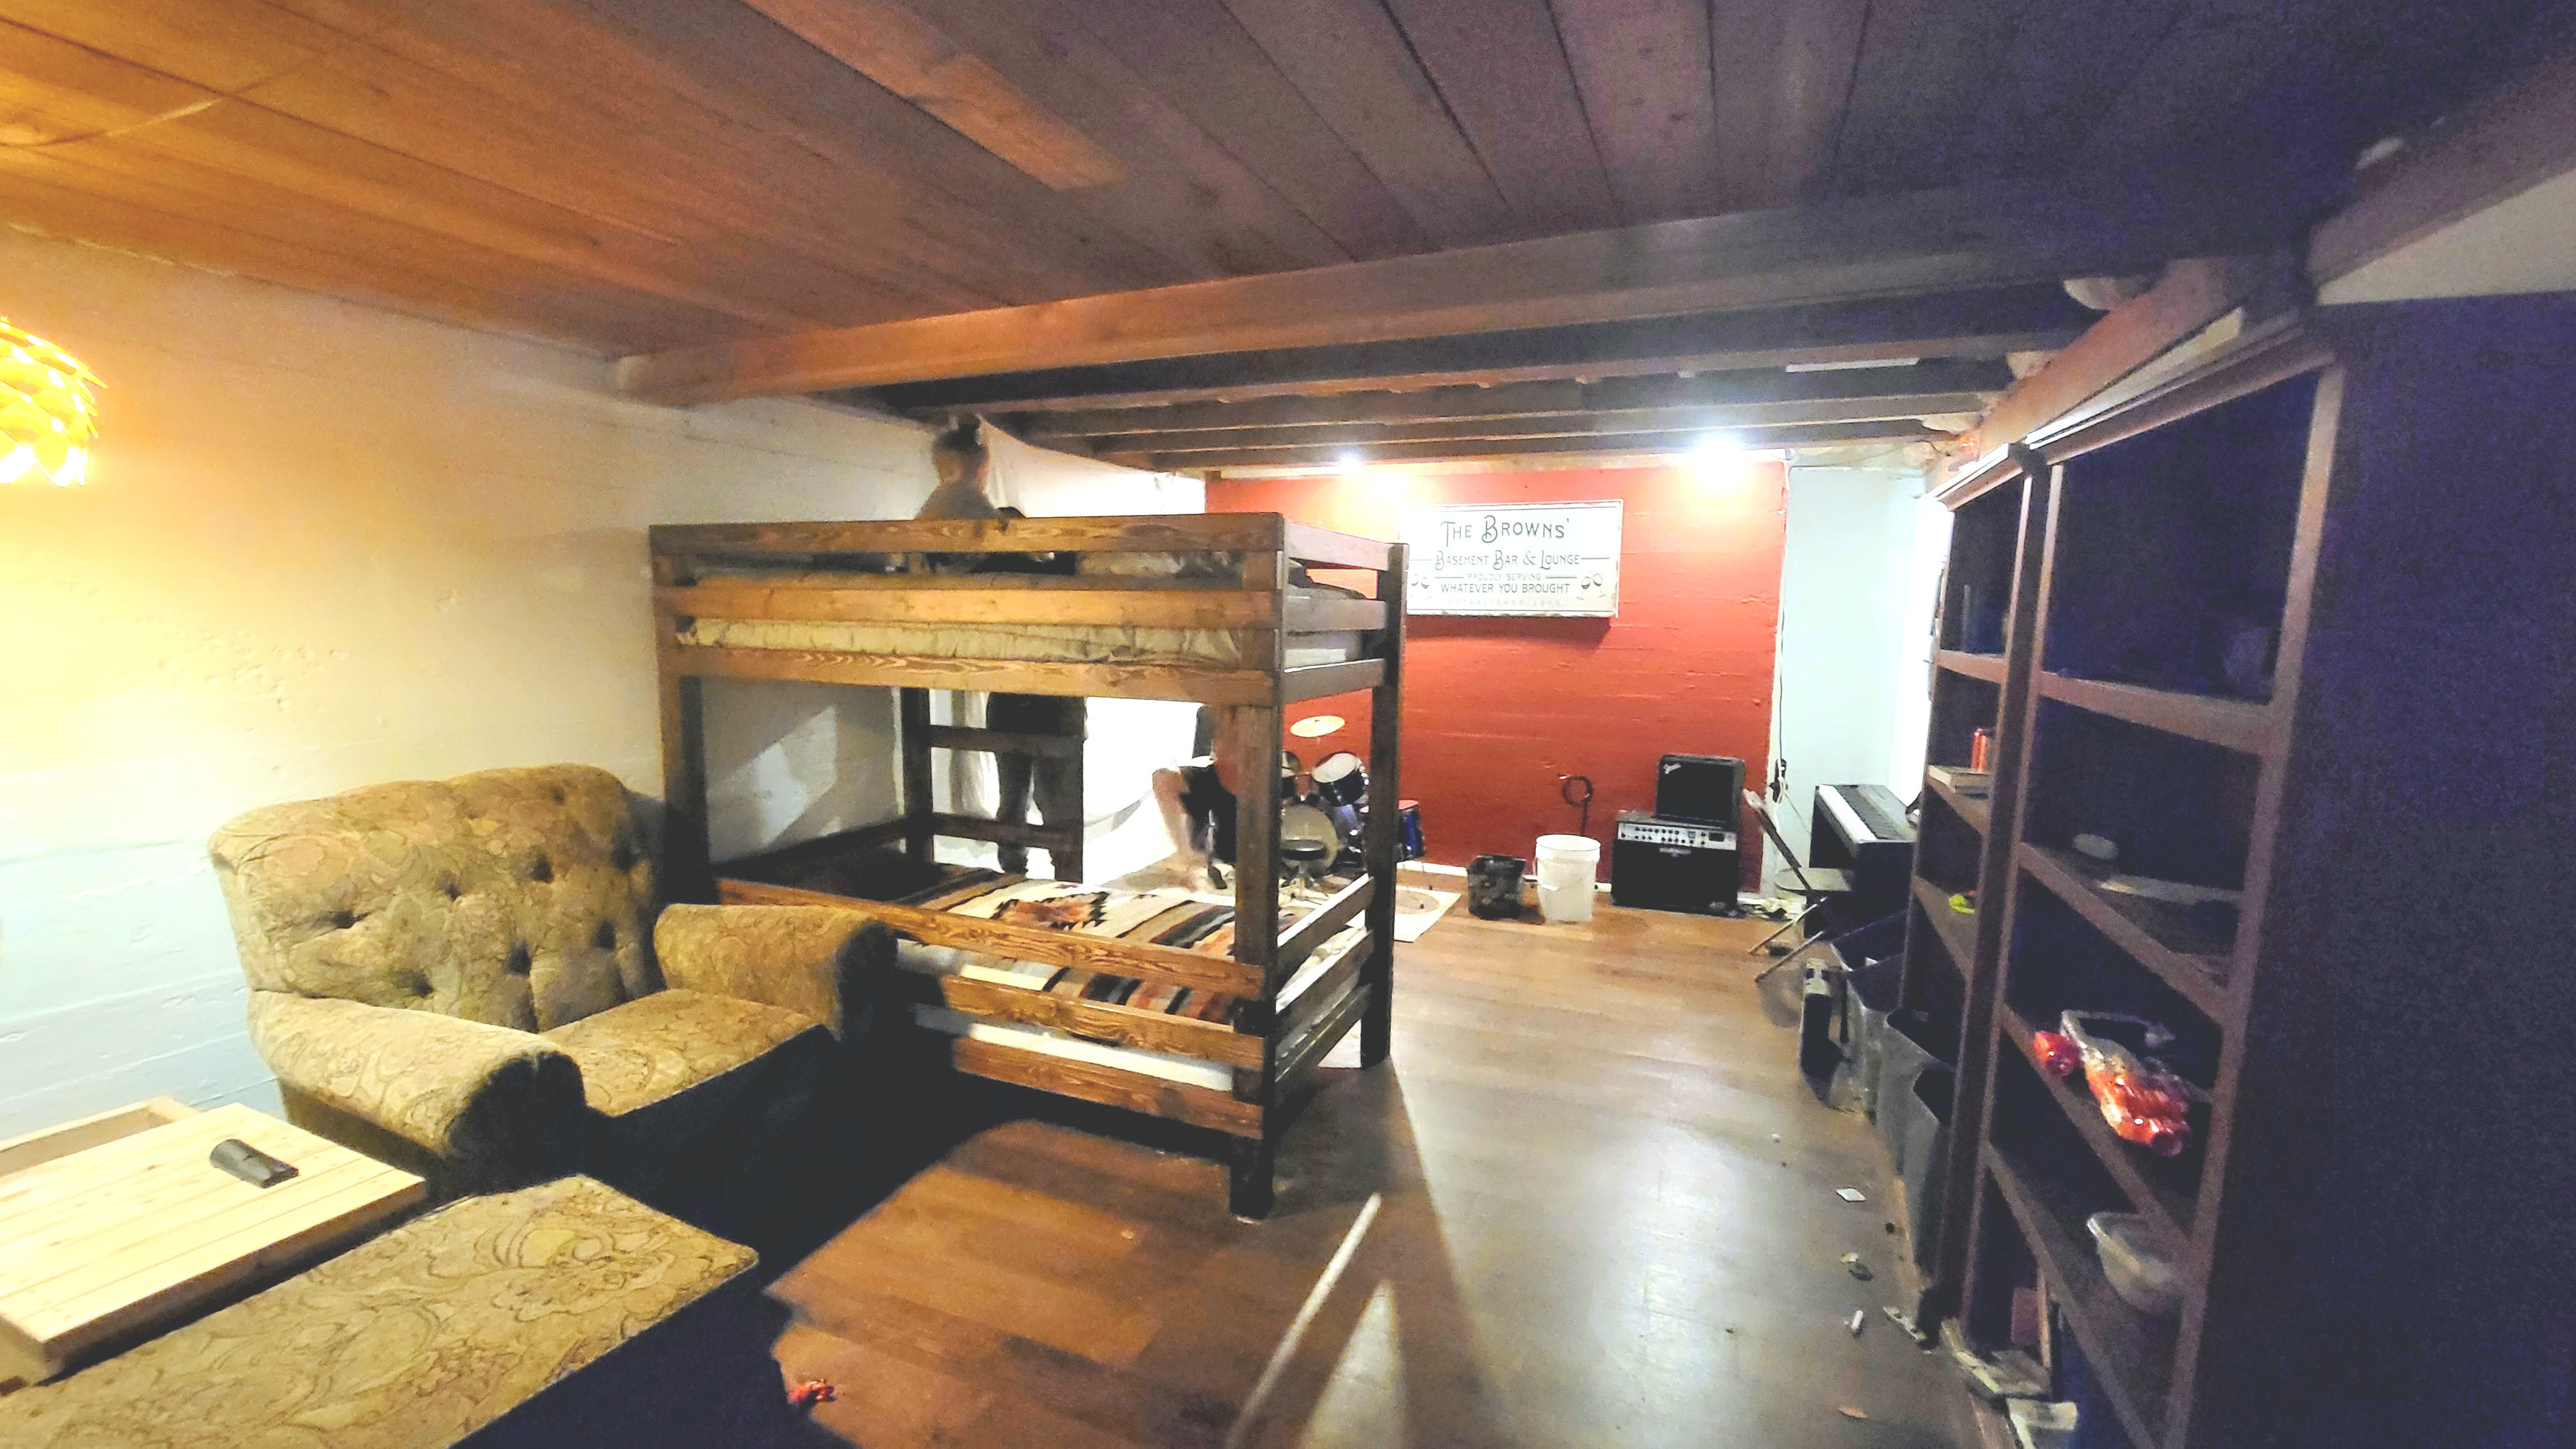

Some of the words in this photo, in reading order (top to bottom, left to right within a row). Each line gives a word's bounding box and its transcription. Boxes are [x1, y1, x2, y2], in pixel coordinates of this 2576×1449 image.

[1440, 521, 1472, 547] THE
[1482, 515, 1569, 543] BROWNS'
[1435, 550, 1489, 571] BASEMENT
[1493, 549, 1517, 570] BAR
[1523, 550, 1537, 565] &
[1540, 549, 1580, 571] LOUNGE
[1441, 583, 1494, 593] WHATEVER
[1499, 583, 1517, 593] YOU
[1522, 583, 1570, 593] BROUGHT
